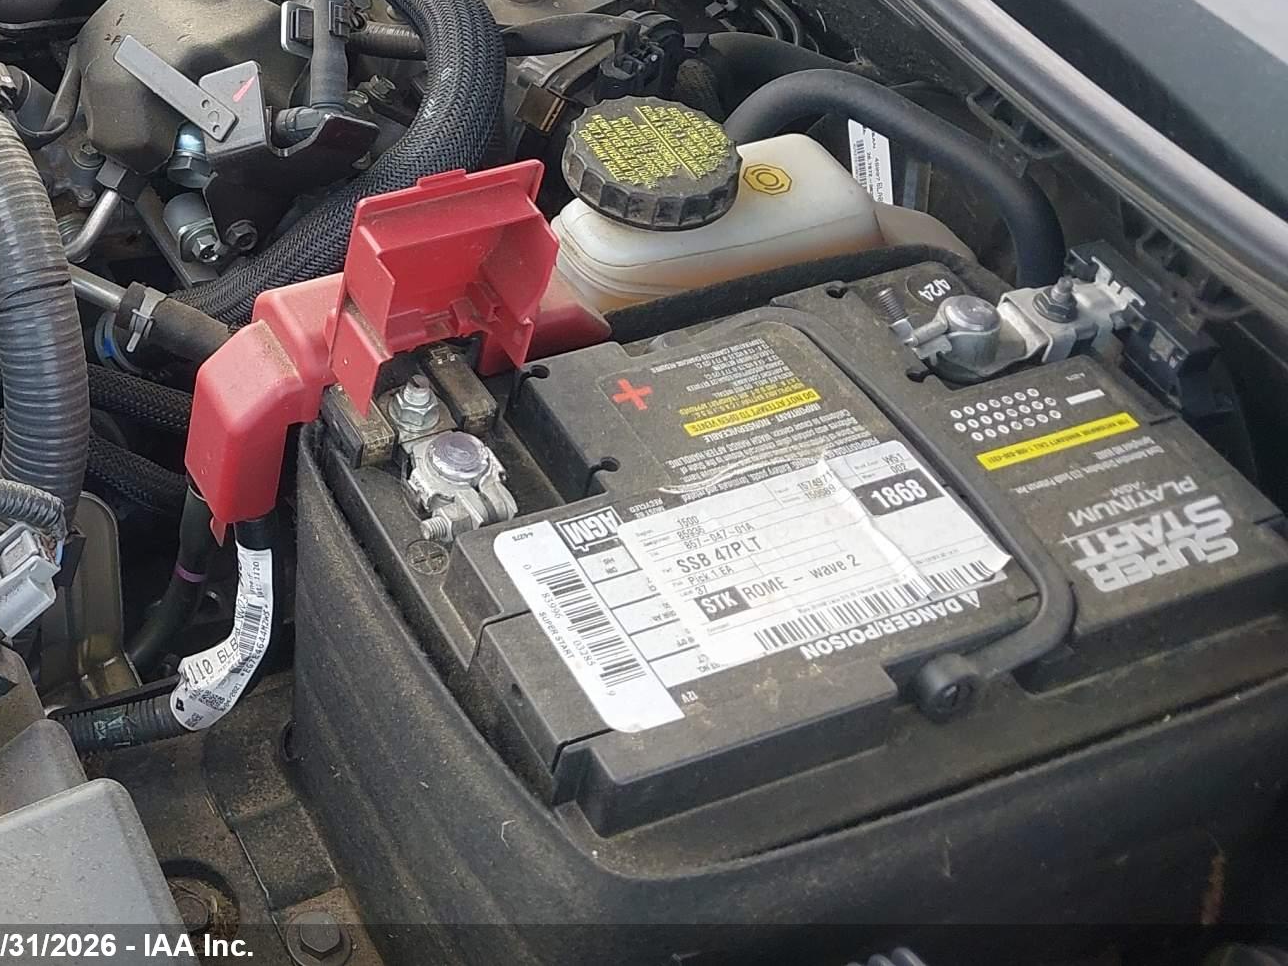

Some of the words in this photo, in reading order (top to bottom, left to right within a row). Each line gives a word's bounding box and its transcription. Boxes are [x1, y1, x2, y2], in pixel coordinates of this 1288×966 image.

[639, 104, 660, 122] FROM
[664, 119, 681, 132] DOT
[918, 278, 952, 302] 4/24
[784, 394, 804, 405] NOT
[802, 390, 817, 399] DO
[715, 413, 739, 425] OPEN
[735, 410, 752, 419] TO
[748, 399, 786, 415] ATTEMPT
[770, 402, 826, 422] IMPORTANT
[699, 418, 775, 443] NONSERVICEABLE
[866, 477, 931, 511] 1868
[1065, 474, 1200, 527] PLATINUM
[562, 510, 620, 545] AGM
[675, 514, 701, 529] 1500
[1061, 494, 1237, 572] START
[674, 551, 713, 574] SSB
[710, 534, 765, 563] 47PLT
[1082, 525, 1244, 594] SUPER
[686, 571, 712, 587] Pick
[717, 563, 735, 576] EA
[698, 589, 739, 616] STK
[740, 574, 790, 602] ROME
[806, 557, 849, 580] wave
[844, 553, 862, 567] 2
[693, 584, 710, 596] 37
[539, 611, 558, 635] SUPER
[554, 634, 576, 660] START
[800, 596, 965, 663] DANGER/POISON
[680, 690, 699, 704] 12V
